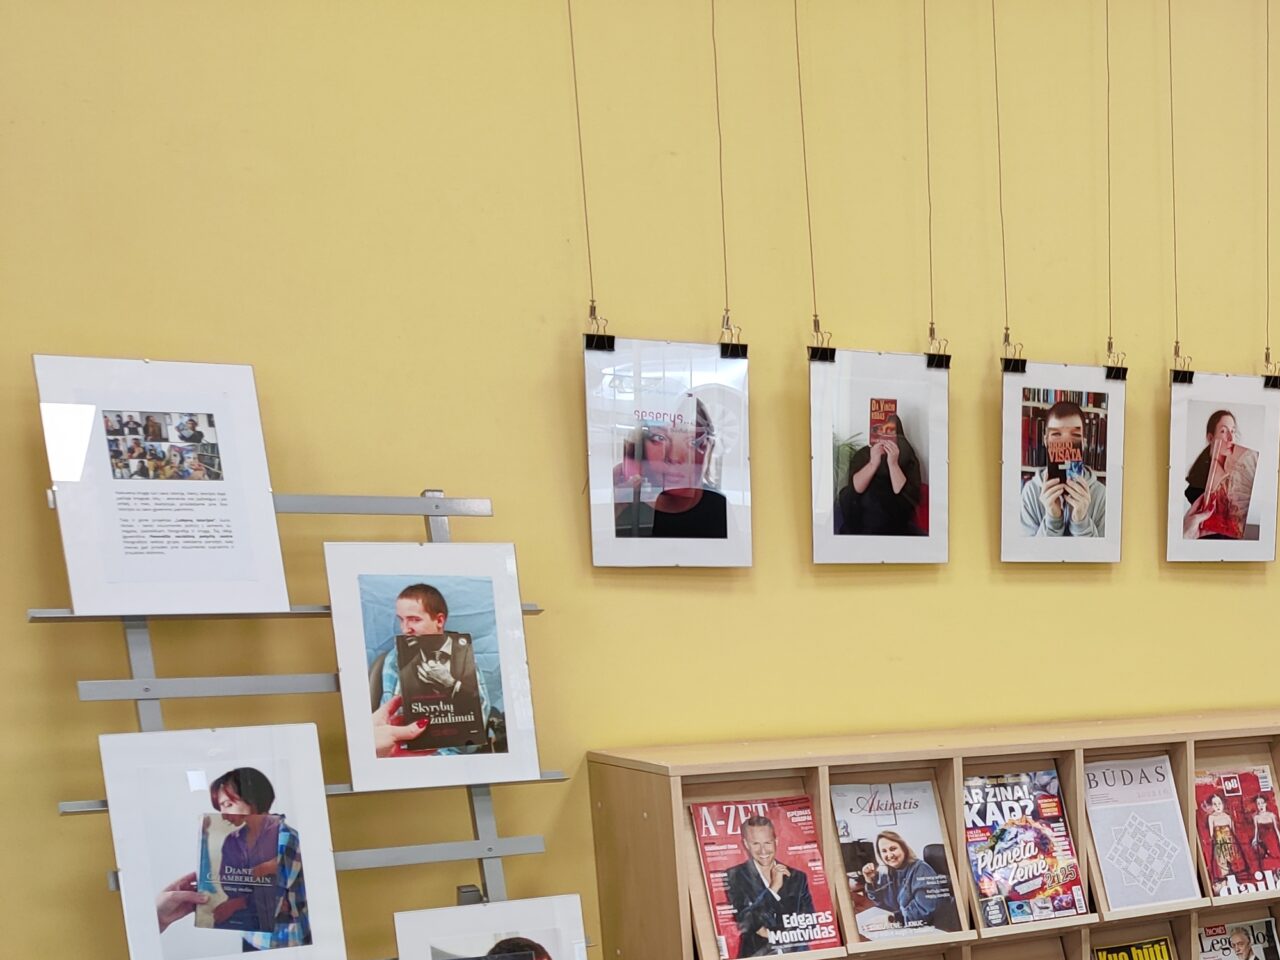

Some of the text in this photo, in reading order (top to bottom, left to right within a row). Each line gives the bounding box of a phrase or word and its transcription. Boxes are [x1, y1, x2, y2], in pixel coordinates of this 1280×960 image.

[1048, 448, 1083, 463] VISATA
[411, 701, 454, 716] Skyrybų
[430, 712, 475, 725] žaidimai
[1086, 765, 1166, 789] BŪDAS
[850, 790, 919, 814] Akiratis
[964, 800, 1035, 828] KAD?
[976, 841, 1038, 875] Planeta
[206, 872, 272, 884] CAMBERLAIN
[782, 910, 833, 928] Edgaras
[768, 925, 836, 945] Montvidas
